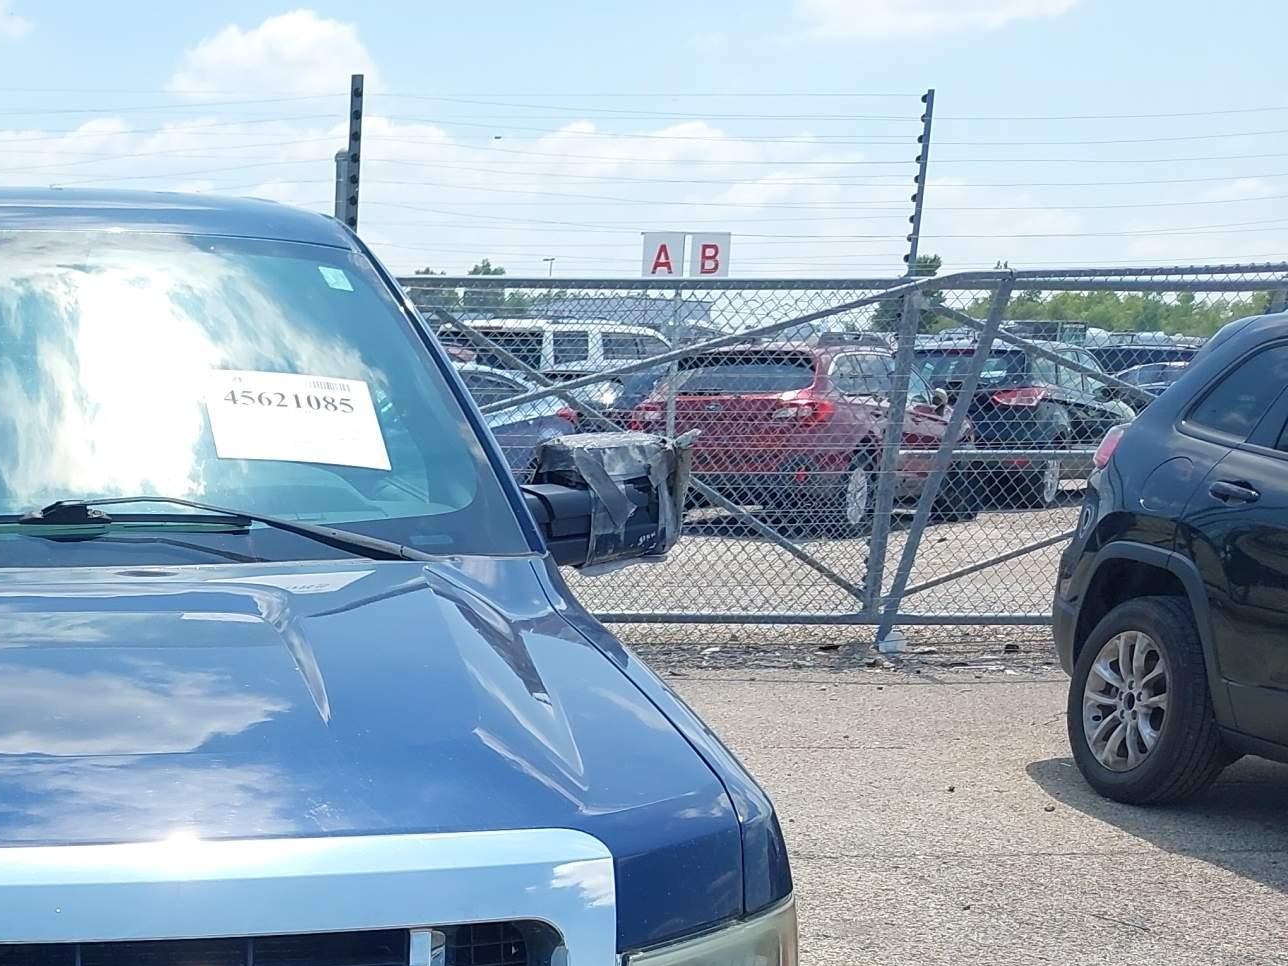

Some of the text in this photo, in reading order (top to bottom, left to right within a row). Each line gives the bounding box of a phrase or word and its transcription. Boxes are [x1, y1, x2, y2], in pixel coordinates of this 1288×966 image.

[650, 243, 673, 274] A
[699, 243, 720, 274] B
[223, 388, 355, 414] 45621085
